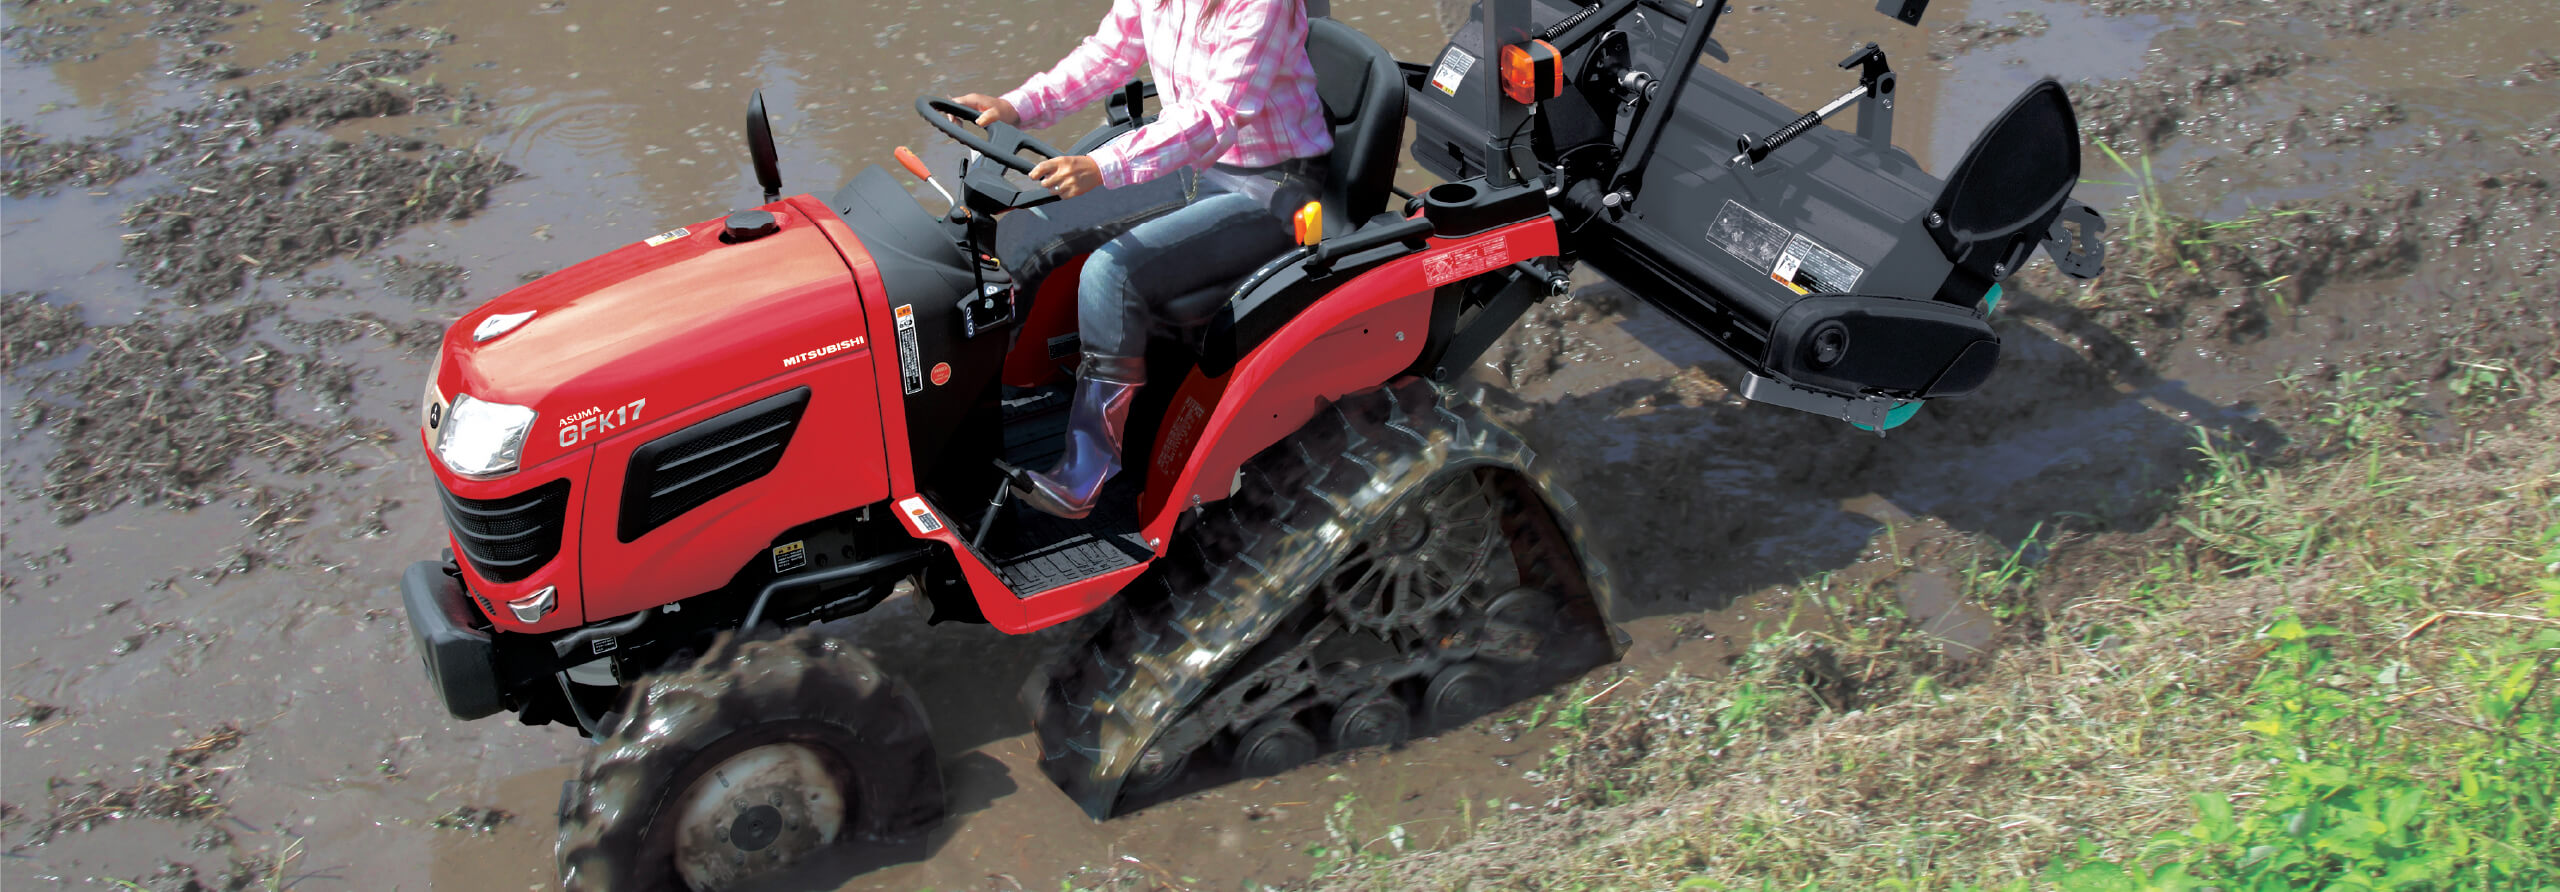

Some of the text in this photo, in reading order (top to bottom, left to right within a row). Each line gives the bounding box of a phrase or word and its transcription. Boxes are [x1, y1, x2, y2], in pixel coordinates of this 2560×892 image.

[966, 307, 972, 320] 2
[967, 322, 974, 335] 3
[783, 336, 865, 367] MITSUBISHI
[559, 406, 601, 427] ASUMA
[559, 398, 646, 447] GFK17
